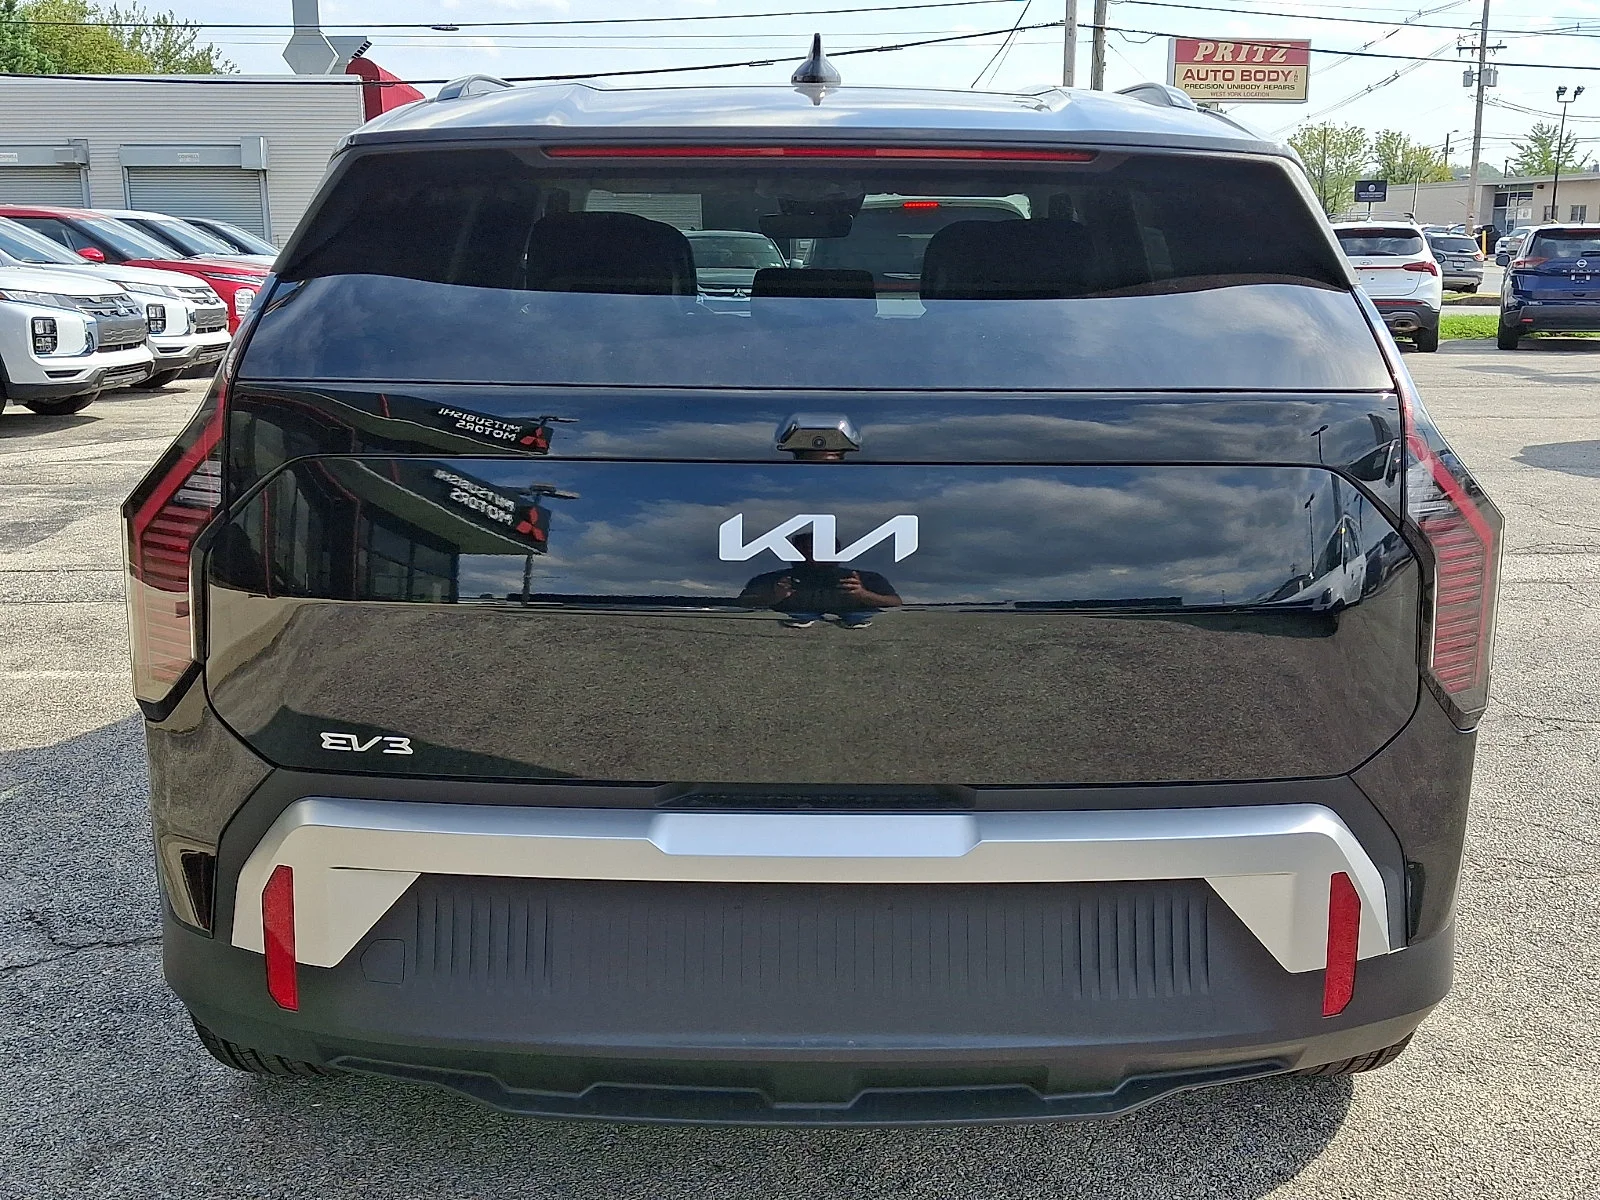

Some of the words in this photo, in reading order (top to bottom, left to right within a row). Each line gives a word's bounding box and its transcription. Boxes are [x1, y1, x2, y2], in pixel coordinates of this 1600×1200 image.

[1193, 42, 1291, 63] PRITZ
[1182, 68, 1235, 82] AUTO
[1240, 69, 1293, 82] BODY
[320, 731, 414, 755] EV3
